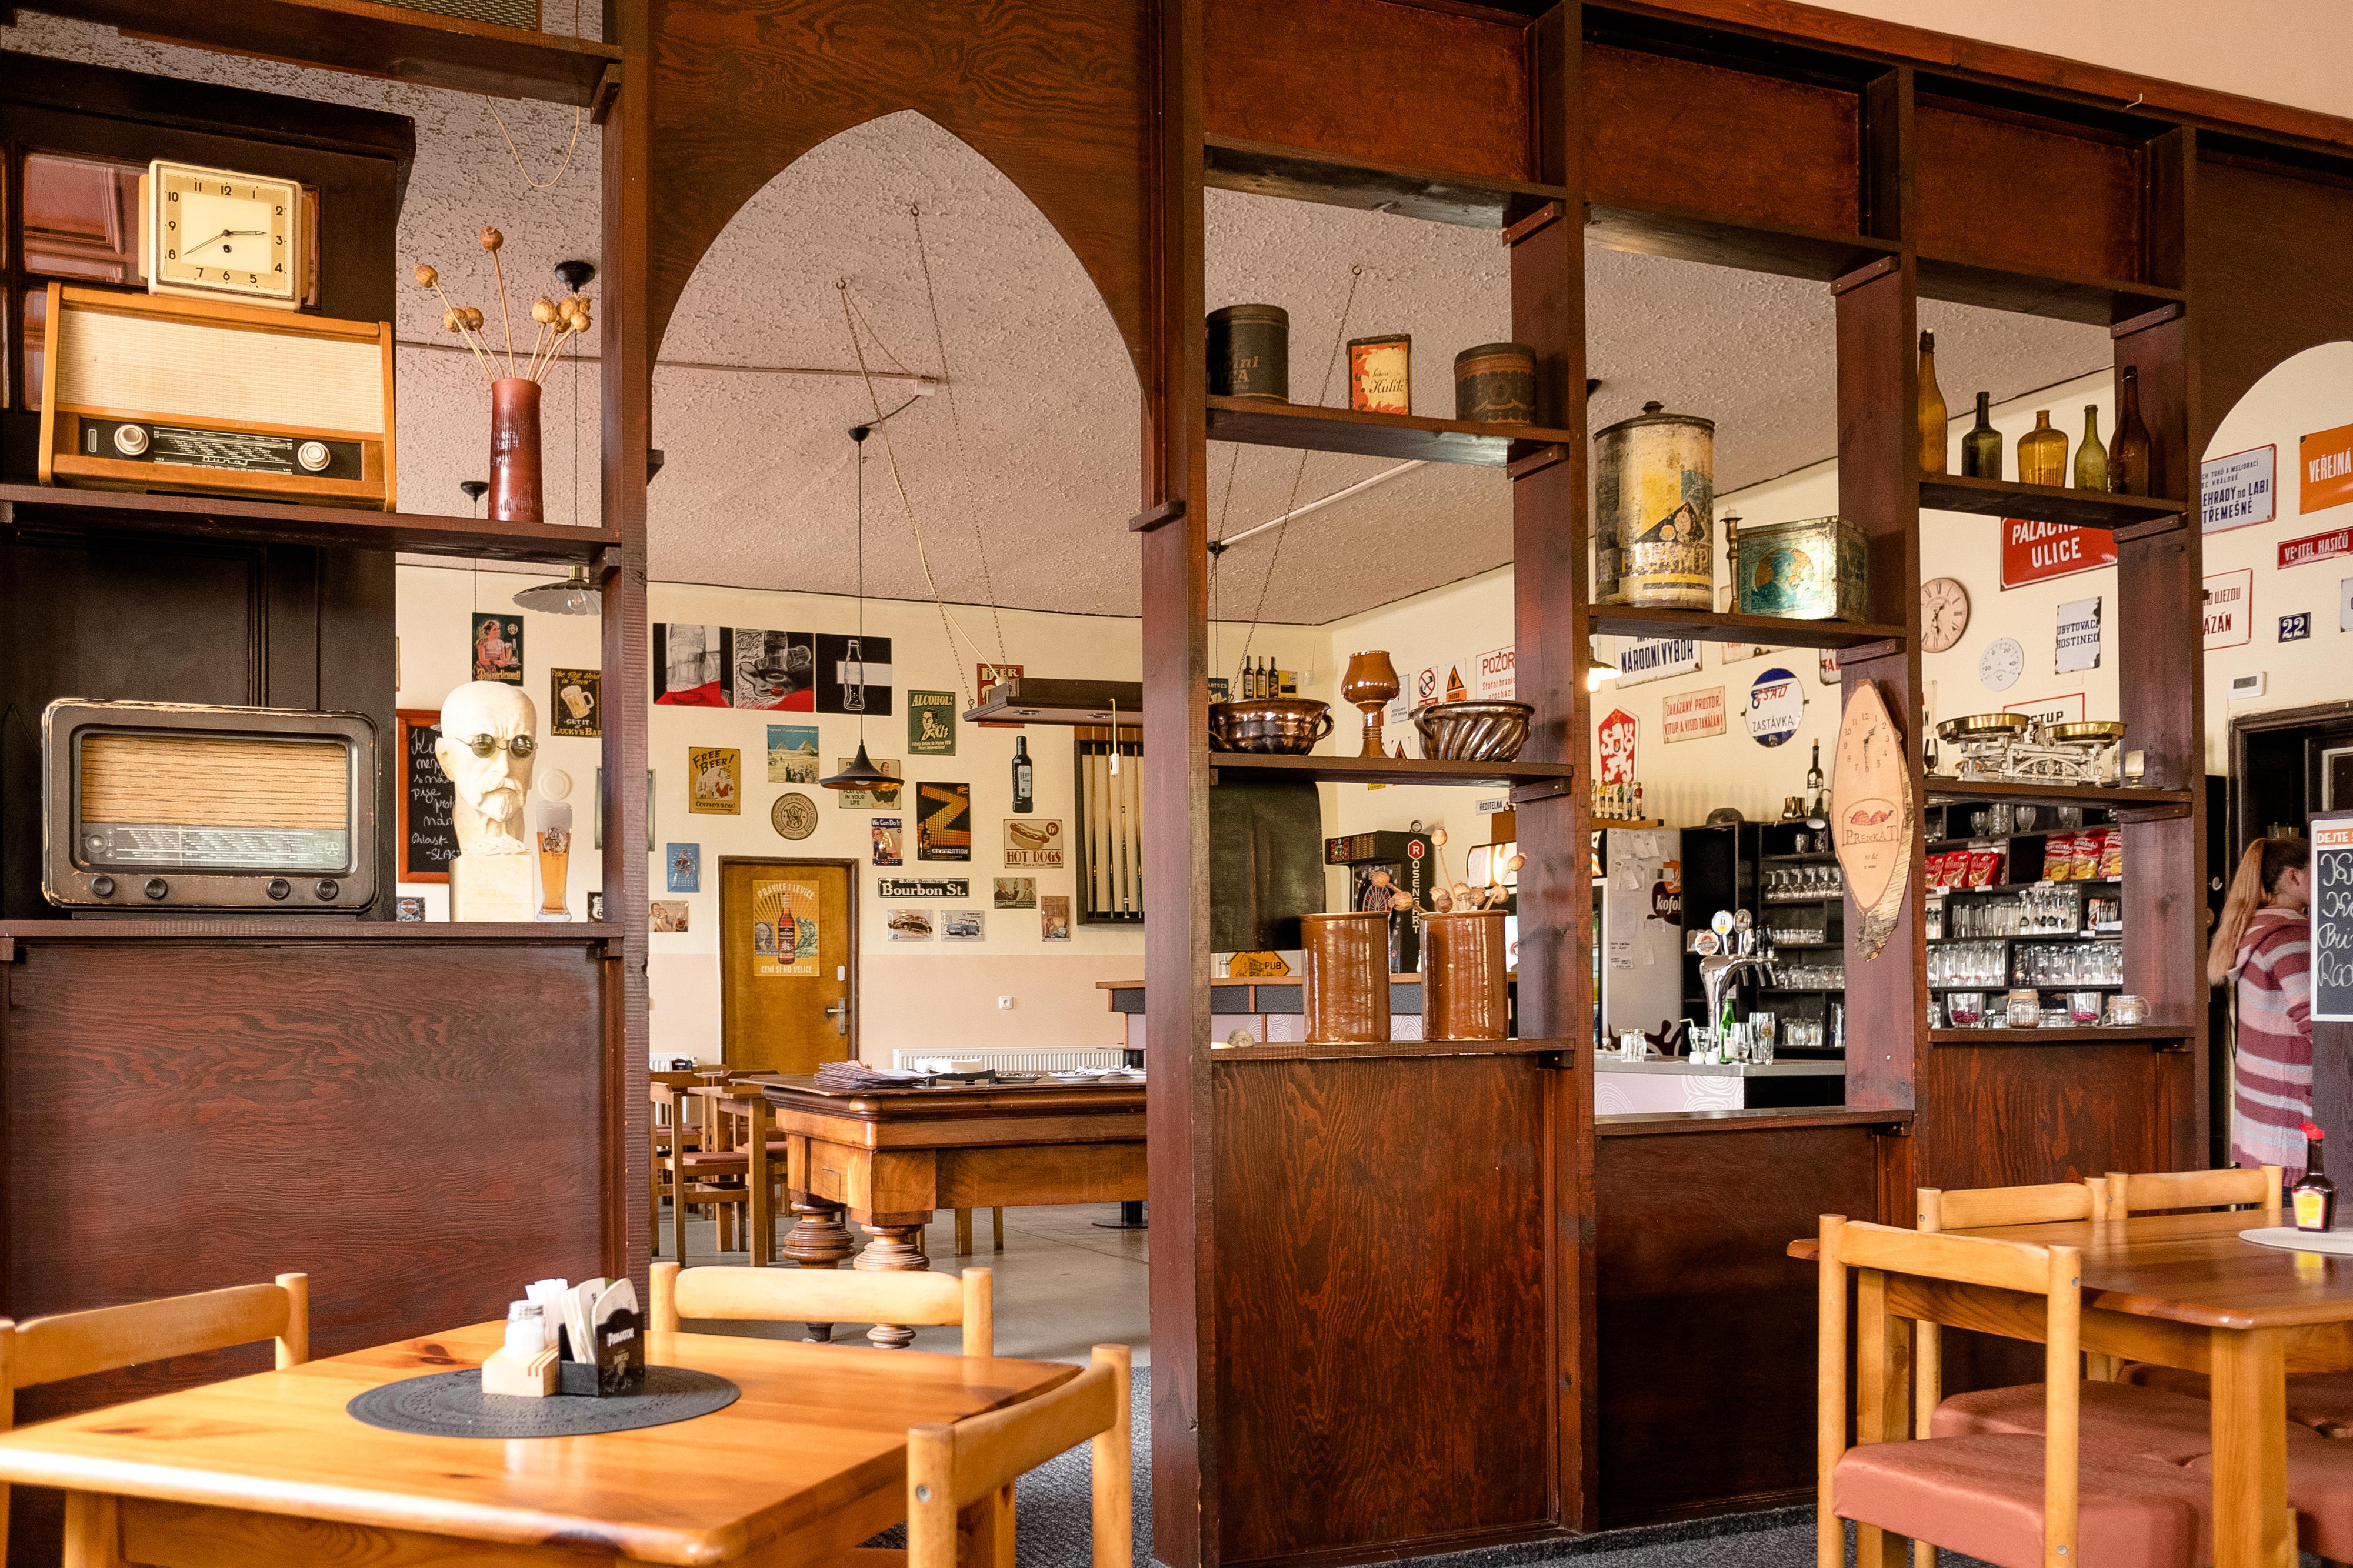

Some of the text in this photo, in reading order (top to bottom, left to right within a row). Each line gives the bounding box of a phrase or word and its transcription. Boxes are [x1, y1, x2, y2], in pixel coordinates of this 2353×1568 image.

[194, 182, 202, 192] 11
[221, 185, 232, 195] 12
[168, 192, 179, 202] 10
[252, 190, 255, 199] 1
[275, 206, 283, 216] 2
[168, 221, 176, 231] 9
[275, 236, 283, 245] 3
[168, 249, 176, 259] 8
[196, 267, 204, 277] 7
[274, 263, 283, 273] 4
[223, 271, 230, 281] 6
[249, 275, 257, 284] 5
[202, 456, 248, 466] Dunaj
[2309, 447, 2352, 483] VEŘEJNÁ
[2212, 473, 2238, 485] KRÁLOVÉ
[2248, 479, 2269, 496] LABI
[2203, 497, 2252, 523] TŘEMEŠNÉ
[2031, 536, 2082, 568] ULICE
[2285, 532, 2348, 561] VEITEL HASIČŮ
[2282, 617, 2305, 639] 22
[1621, 640, 1660, 673] NÁRODNÍ
[981, 668, 1019, 680] BEER
[912, 695, 953, 706] ALCOHOL!
[1680, 721, 1684, 733] A
[1752, 715, 1794, 733] ZASTÁVKA
[554, 726, 584, 735] LUCKY'S
[692, 750, 721, 769] FREE
[699, 753, 735, 776] BEER!
[696, 800, 735, 809] tomorrow
[1479, 800, 1503, 812] ŘEDITELKA
[2317, 832, 2349, 843] DEJTE
[1006, 850, 1061, 863] HOT DOGS
[757, 883, 786, 899] PRAVICE
[793, 883, 815, 900] LEVICE
[882, 883, 966, 895] Bourbon St.
[784, 965, 792, 973] HO
[794, 965, 812, 973] VELICE
